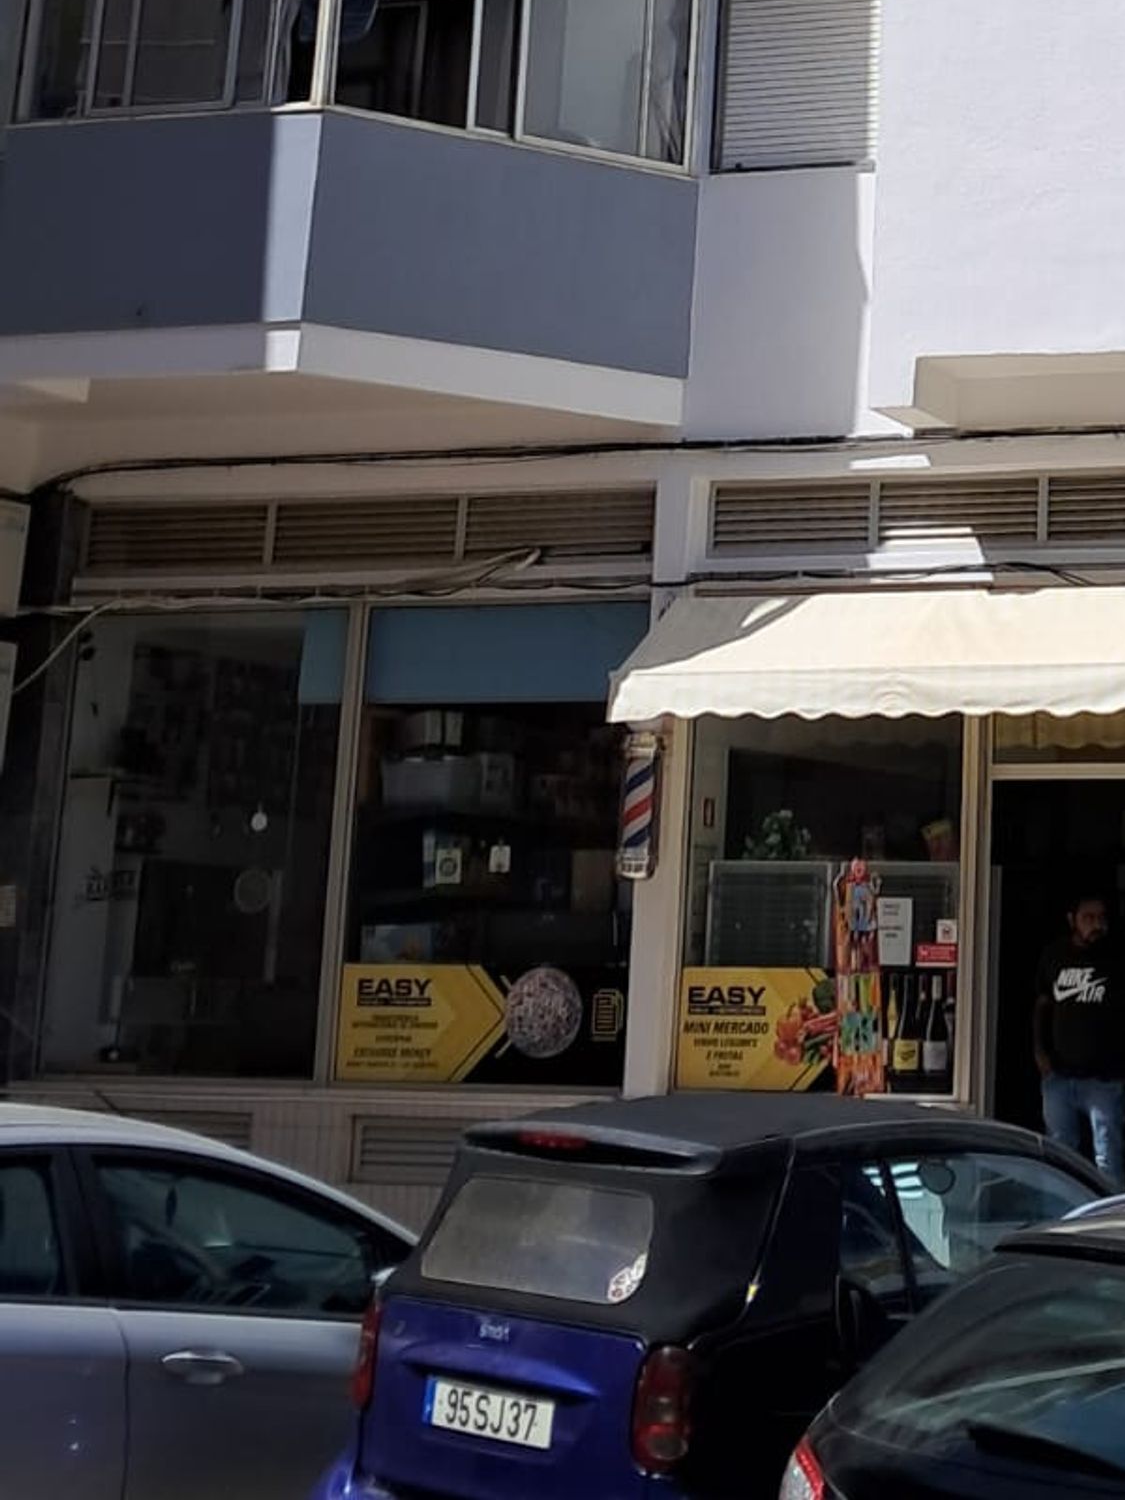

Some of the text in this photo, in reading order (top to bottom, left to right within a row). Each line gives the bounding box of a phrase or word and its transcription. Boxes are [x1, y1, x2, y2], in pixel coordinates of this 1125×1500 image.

[357, 977, 432, 997] EASY
[1057, 966, 1096, 989] NIKE
[687, 985, 766, 1005] EASY
[1075, 984, 1106, 1002] AIR
[683, 1020, 770, 1035] MINI MERCADO
[445, 1388, 538, 1441] 95SJ37
